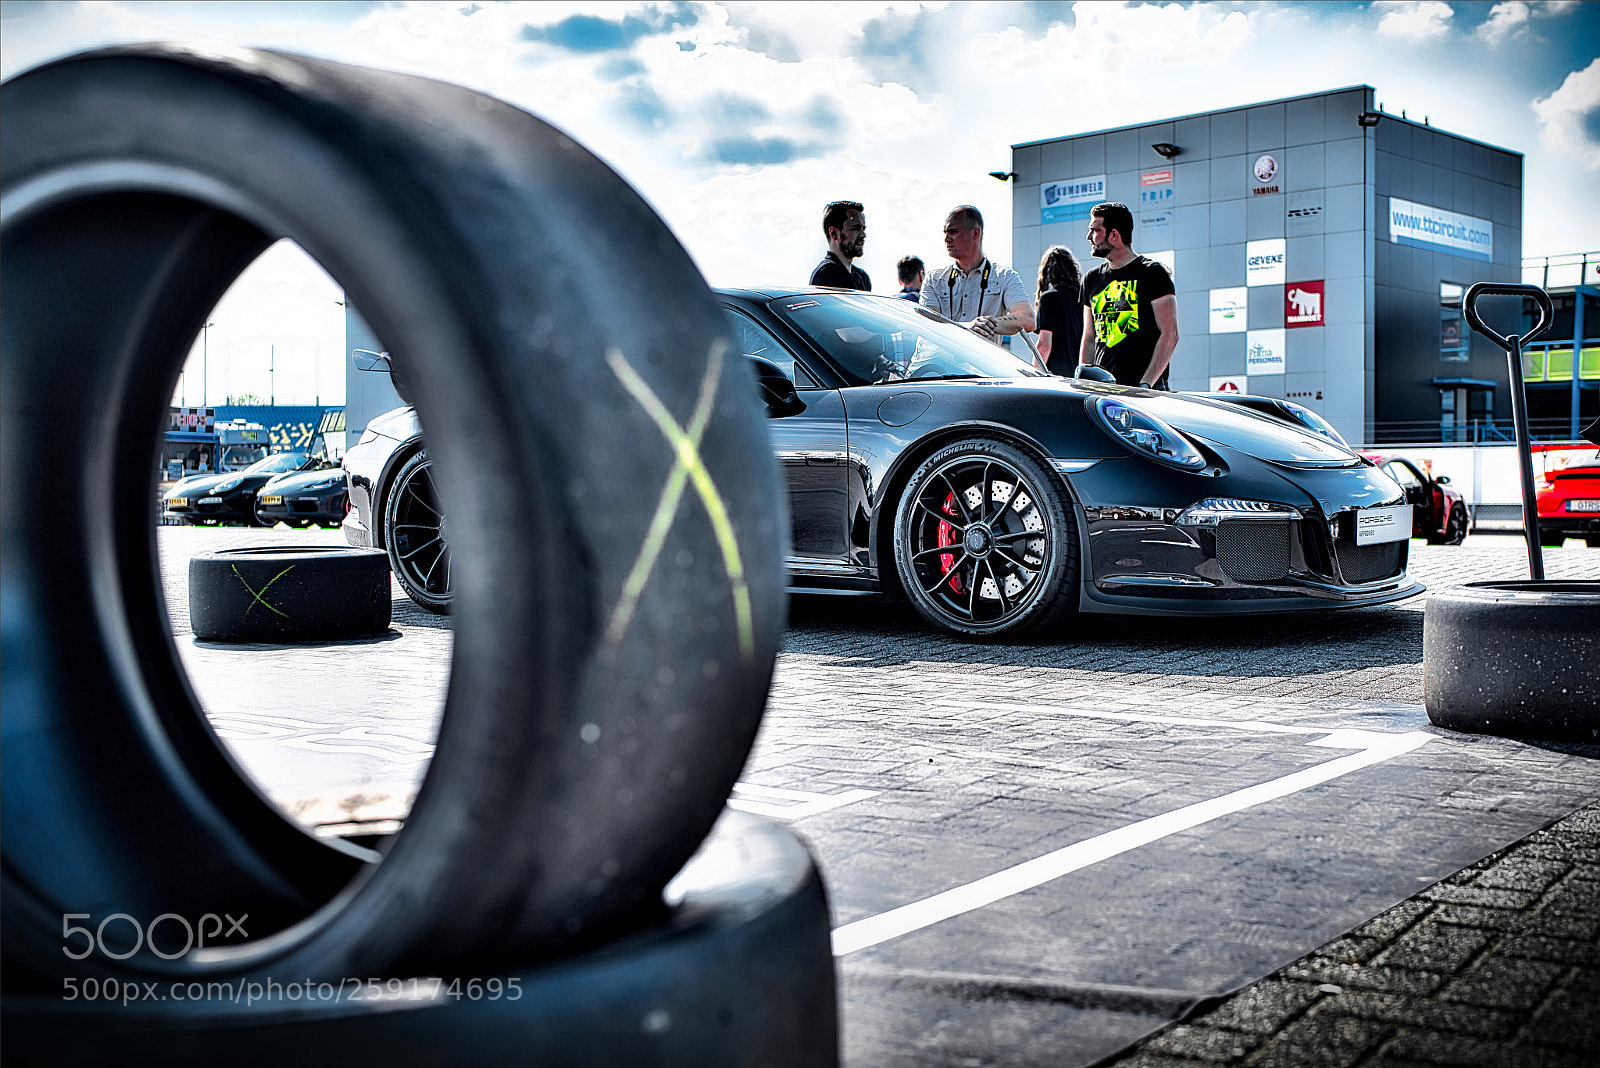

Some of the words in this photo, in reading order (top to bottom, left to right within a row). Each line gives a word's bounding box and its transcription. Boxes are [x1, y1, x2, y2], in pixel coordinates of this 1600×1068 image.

[1141, 189, 1173, 202] TRIP
[1252, 185, 1279, 196] YAMAHA
[1392, 211, 1490, 246] www.ttcircuit.com
[1247, 253, 1284, 266] GEVEKE
[933, 442, 977, 463] MICHELIN
[1359, 514, 1393, 524] PORSCHE
